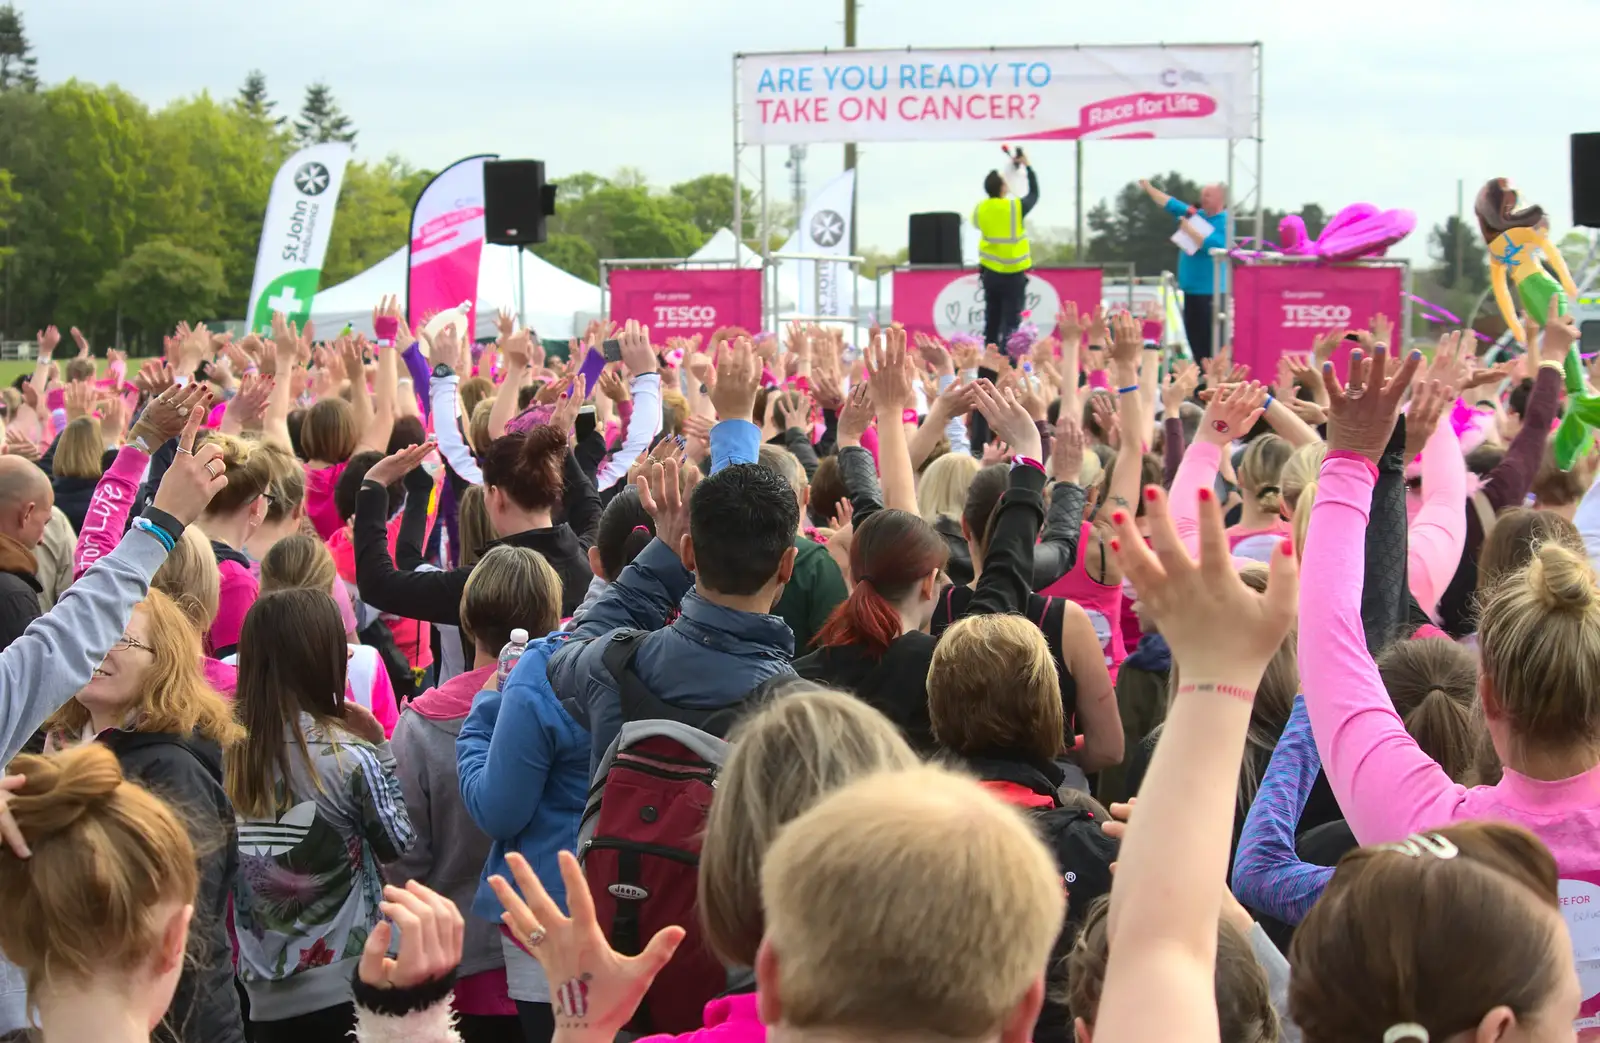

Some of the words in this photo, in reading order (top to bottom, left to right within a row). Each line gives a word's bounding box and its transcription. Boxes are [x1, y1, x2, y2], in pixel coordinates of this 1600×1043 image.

[757, 67, 814, 93] ARE
[823, 65, 888, 91] YOU
[899, 63, 1000, 89] READY
[1007, 62, 1052, 87] TO
[756, 97, 829, 124] TAKE
[838, 96, 887, 122] ON
[897, 93, 1041, 121] CANCER?
[1088, 104, 1135, 127] Race
[1136, 97, 1164, 116] for
[1165, 94, 1200, 112] Life
[286, 200, 308, 242] John
[281, 244, 299, 262] St
[653, 305, 716, 321] TESCO
[1281, 304, 1352, 321] TESCO
[85, 483, 123, 532] Life
[1571, 894, 1591, 905] FOR
